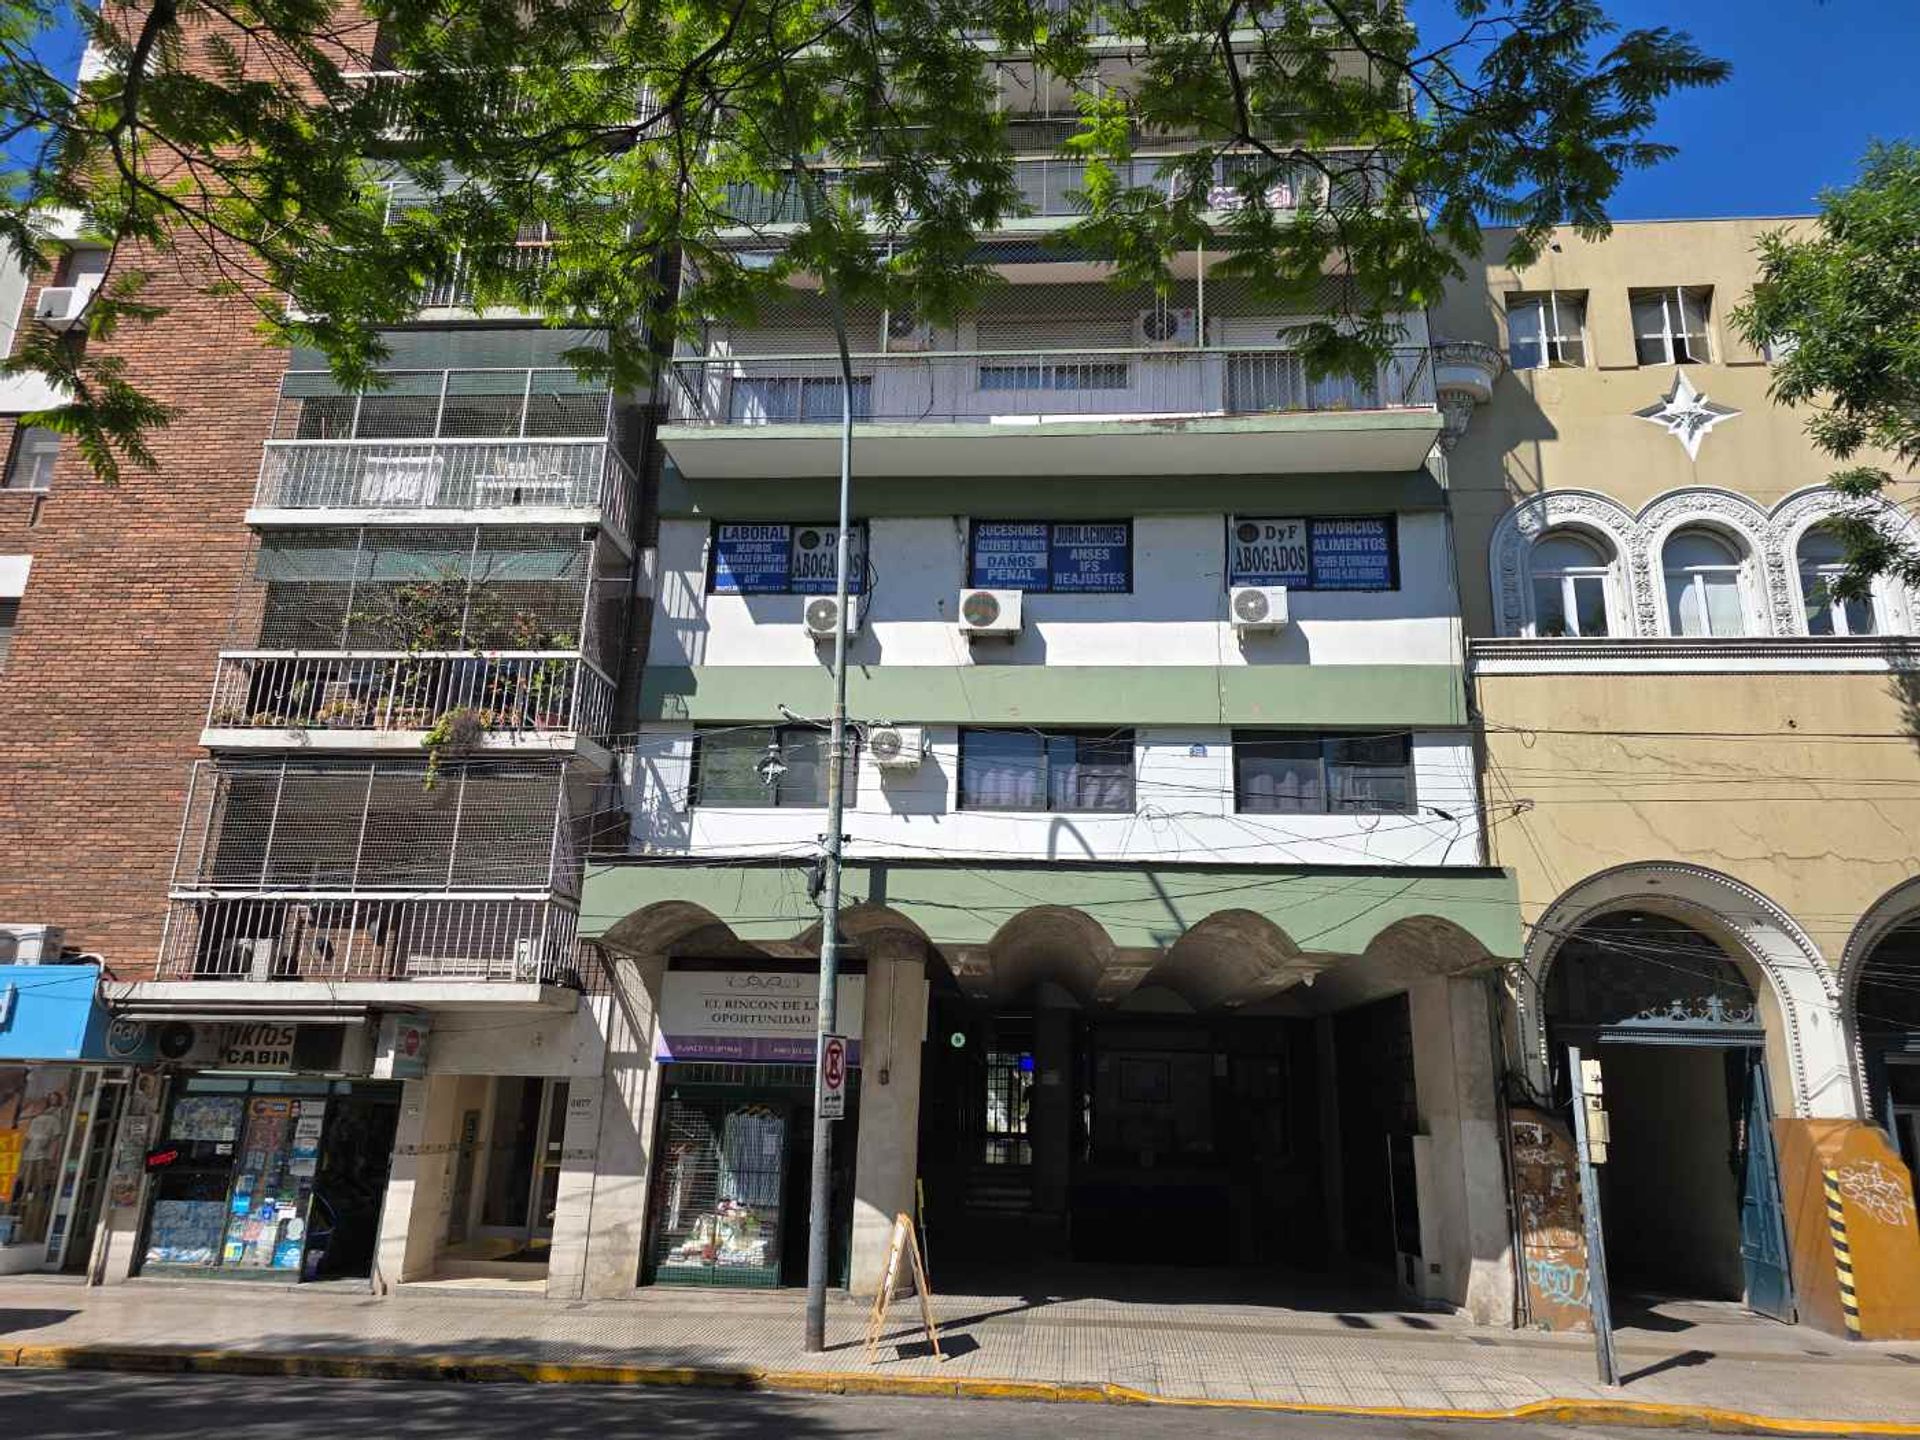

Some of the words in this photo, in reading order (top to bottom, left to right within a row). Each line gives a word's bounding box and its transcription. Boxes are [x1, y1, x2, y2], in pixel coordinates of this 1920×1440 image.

[723, 527, 787, 540] LABORAL
[978, 525, 1046, 537] SUCESIONES
[1264, 525, 1297, 542] DyF
[1313, 537, 1387, 551] ALIMENTOS
[987, 554, 1035, 567] DAÑOS
[1070, 548, 1110, 561] ANSES
[1235, 546, 1305, 572] ABOGADOS
[792, 553, 861, 578] ABOGAOS
[988, 569, 1035, 581] PENAL
[1054, 573, 1126, 585] REAJUSTES
[704, 1000, 720, 1009] EL
[725, 1000, 779, 1010] RINCON
[783, 1001, 801, 1010] DE
[711, 1013, 811, 1024] OPORTUNIDAD
[227, 1050, 289, 1065] CABIN
